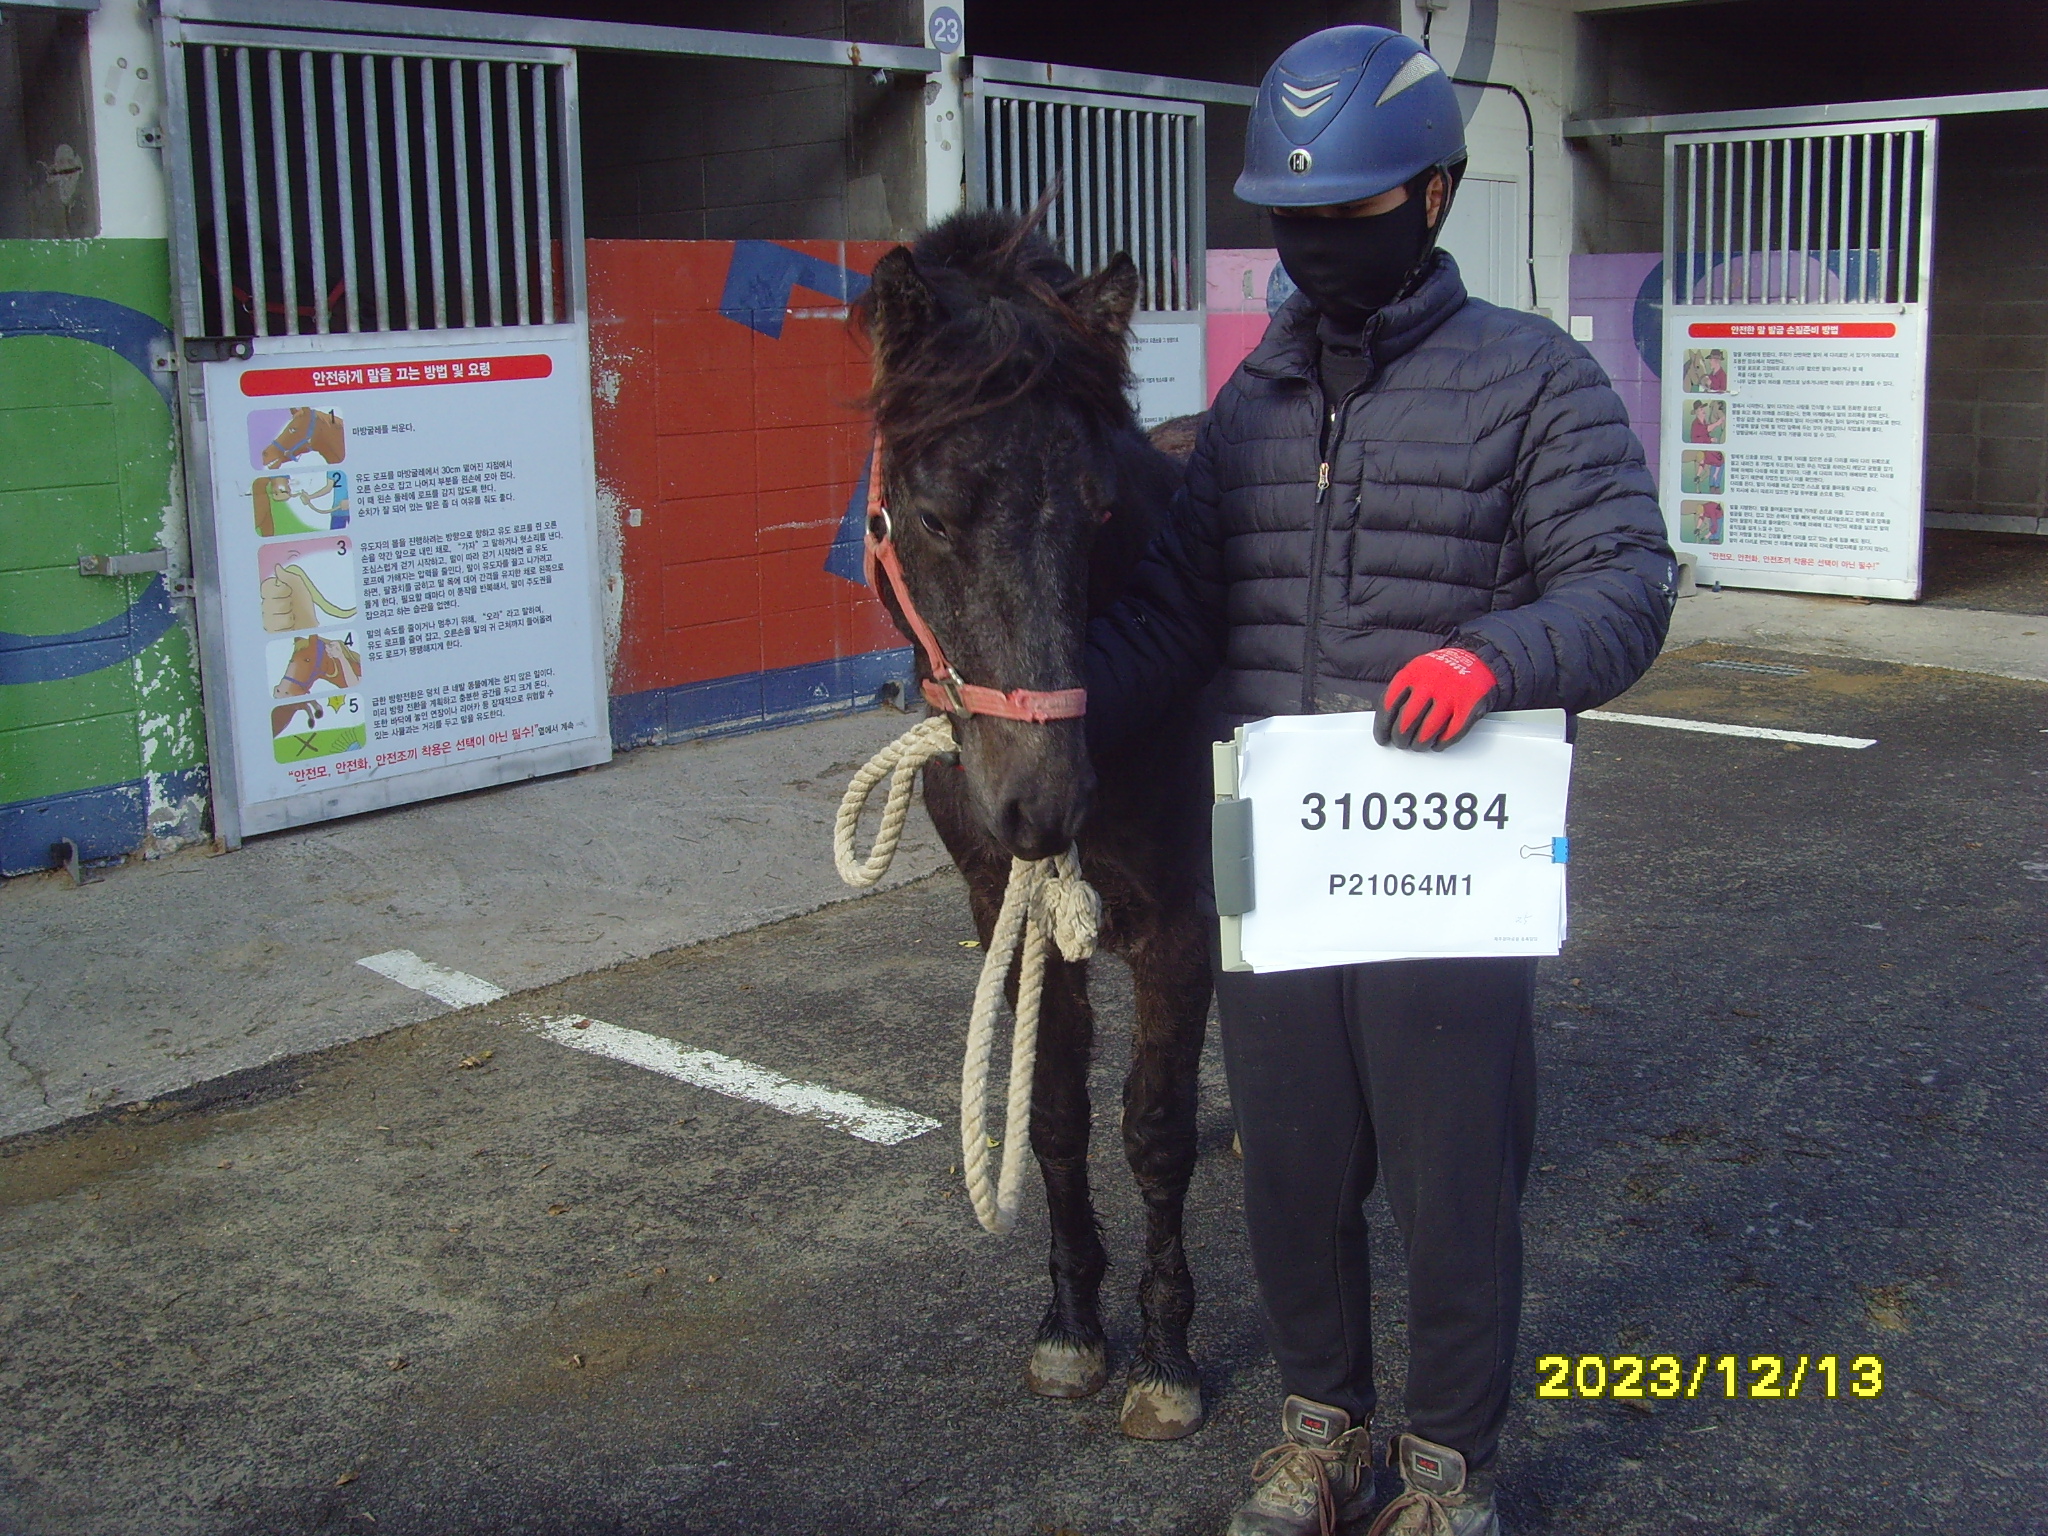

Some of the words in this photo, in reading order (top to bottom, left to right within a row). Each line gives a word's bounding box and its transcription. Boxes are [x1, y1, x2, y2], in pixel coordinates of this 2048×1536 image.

[934, 17, 959, 44] 23
[1731, 325, 1755, 335] 안전한
[312, 369, 363, 387] 안전하게
[367, 367, 392, 383] 말을
[396, 366, 420, 381] 끄는
[424, 364, 448, 380] 방법
[452, 363, 464, 378] 및
[468, 361, 491, 377] 요령
[328, 409, 335, 424] 1
[332, 472, 342, 488] 2
[337, 540, 347, 556] 3
[343, 632, 353, 646] 4
[349, 698, 359, 713] 5
[288, 766, 331, 783] “안전모,
[335, 757, 371, 775] 안전화,
[375, 747, 418, 768] 안전조끼
[422, 741, 452, 757] 착용은
[456, 735, 485, 751] 선택이
[488, 730, 508, 744] 아닌
[511, 723, 539, 741] 필수!”
[1301, 792, 1509, 831] 3103384
[1329, 873, 1472, 896] P21064M1
